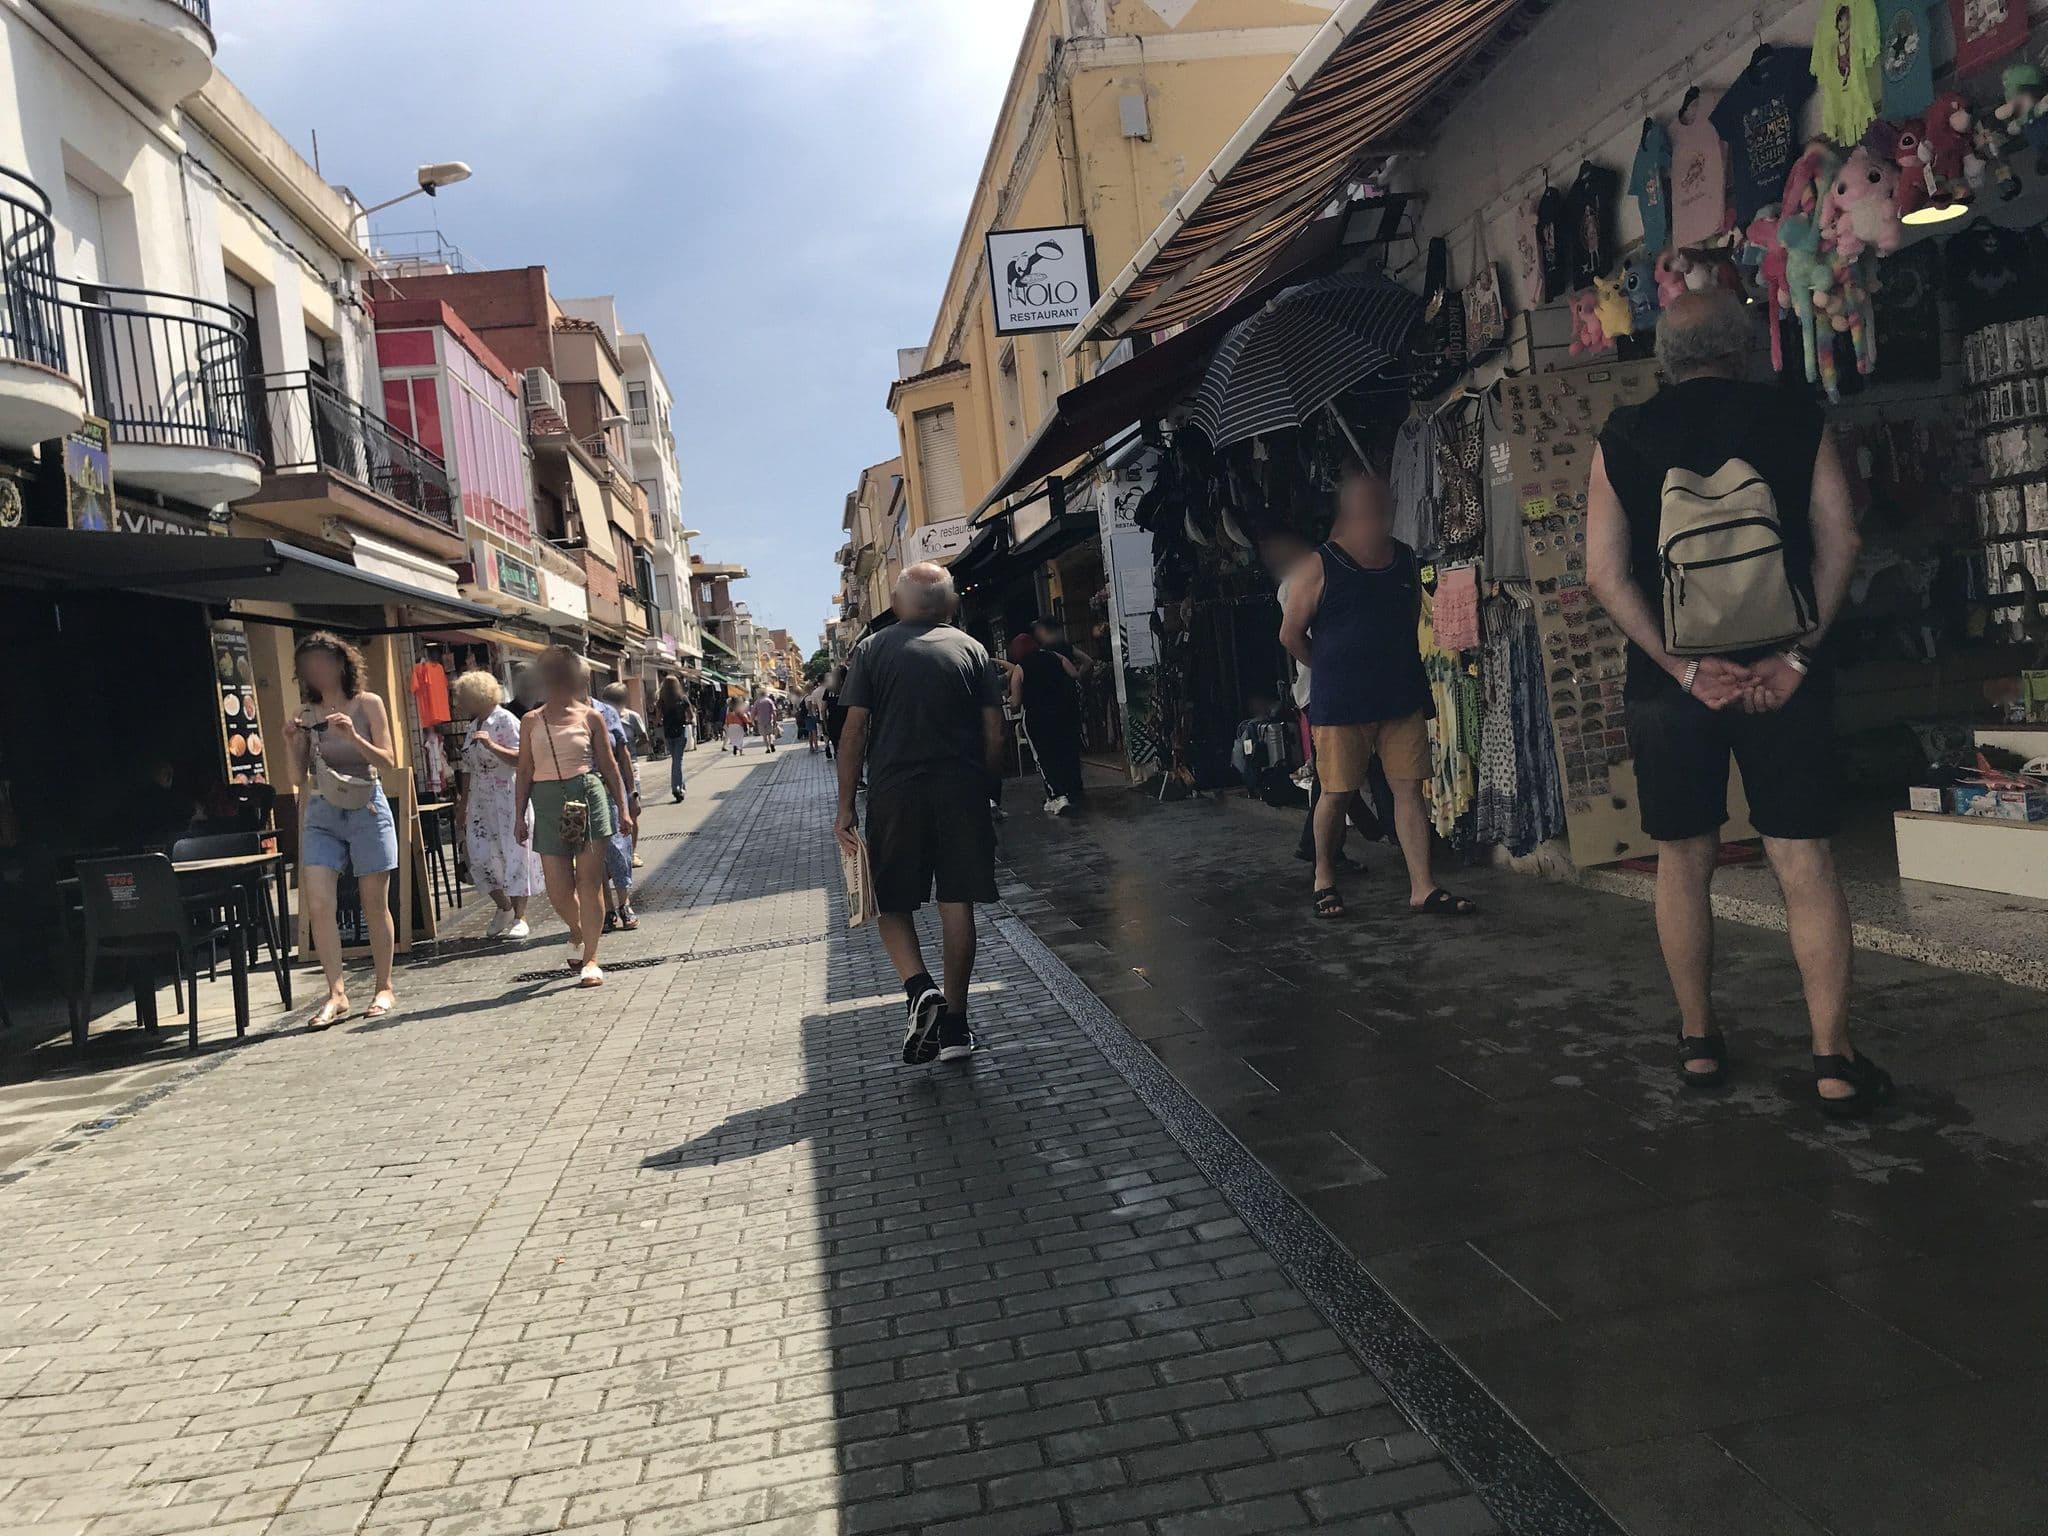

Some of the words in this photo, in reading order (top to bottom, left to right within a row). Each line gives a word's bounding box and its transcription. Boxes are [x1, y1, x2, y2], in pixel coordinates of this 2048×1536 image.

[1009, 308, 1079, 322] RESTAURANT
[940, 523, 979, 538] restauran
[1115, 521, 1137, 529] RESTAU
